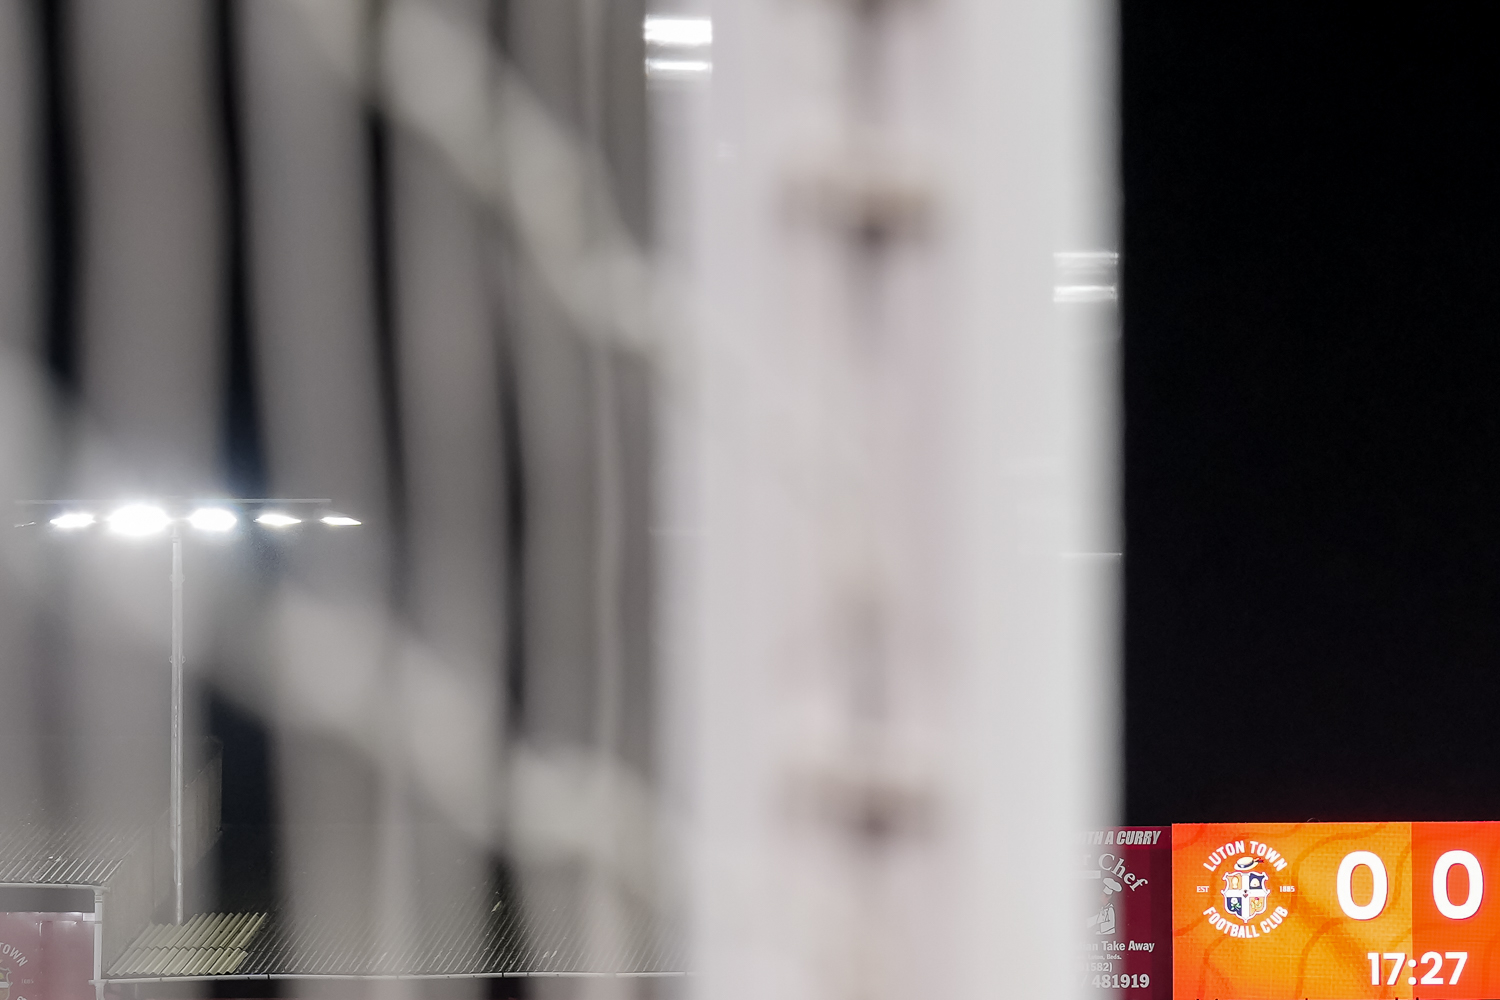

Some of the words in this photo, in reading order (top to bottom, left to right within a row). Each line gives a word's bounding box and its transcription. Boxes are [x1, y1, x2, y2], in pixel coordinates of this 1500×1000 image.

[1105, 831, 1114, 845] A
[1116, 830, 1162, 845] CURRY
[1203, 840, 1245, 872] LUTON
[1250, 840, 1288, 872] TOWN
[1099, 853, 1148, 892] Chef
[1336, 851, 1389, 920] 0
[1432, 850, 1484, 920] 0
[1196, 885, 1210, 893] EST
[1279, 885, 1295, 893] 1885
[1203, 906, 1260, 939] FOOTBALL
[1260, 906, 1289, 934] CLUB
[1101, 941, 1126, 951] Take
[1128, 941, 1155, 952] Away
[1091, 974, 1150, 988] 481919
[1367, 952, 1469, 986] 17:27
